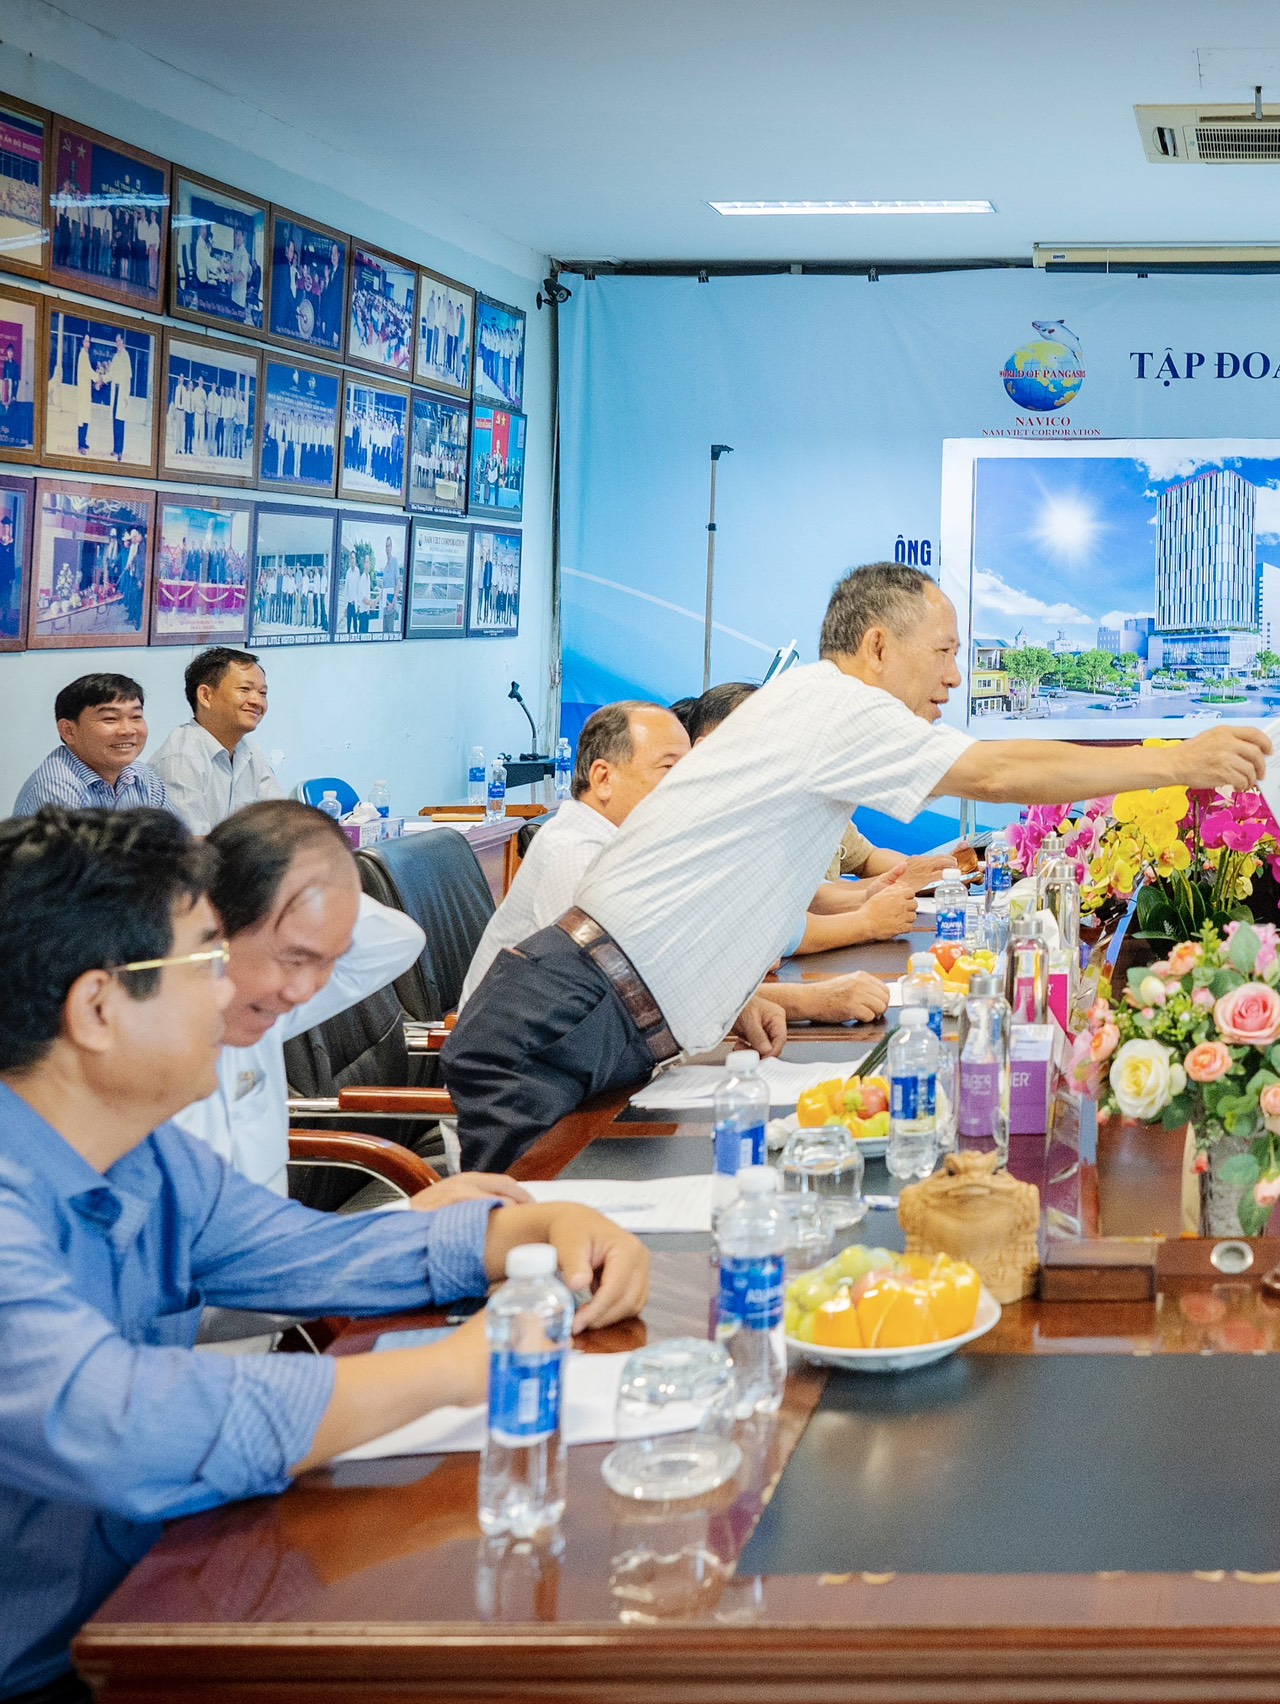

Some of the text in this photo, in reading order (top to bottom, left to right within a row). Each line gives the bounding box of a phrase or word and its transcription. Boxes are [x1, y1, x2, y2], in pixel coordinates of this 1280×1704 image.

[1026, 370, 1042, 379] OF
[1129, 347, 1205, 387] TẬP
[1015, 417, 1071, 427] NAVICO
[894, 534, 932, 566] ÔNG
